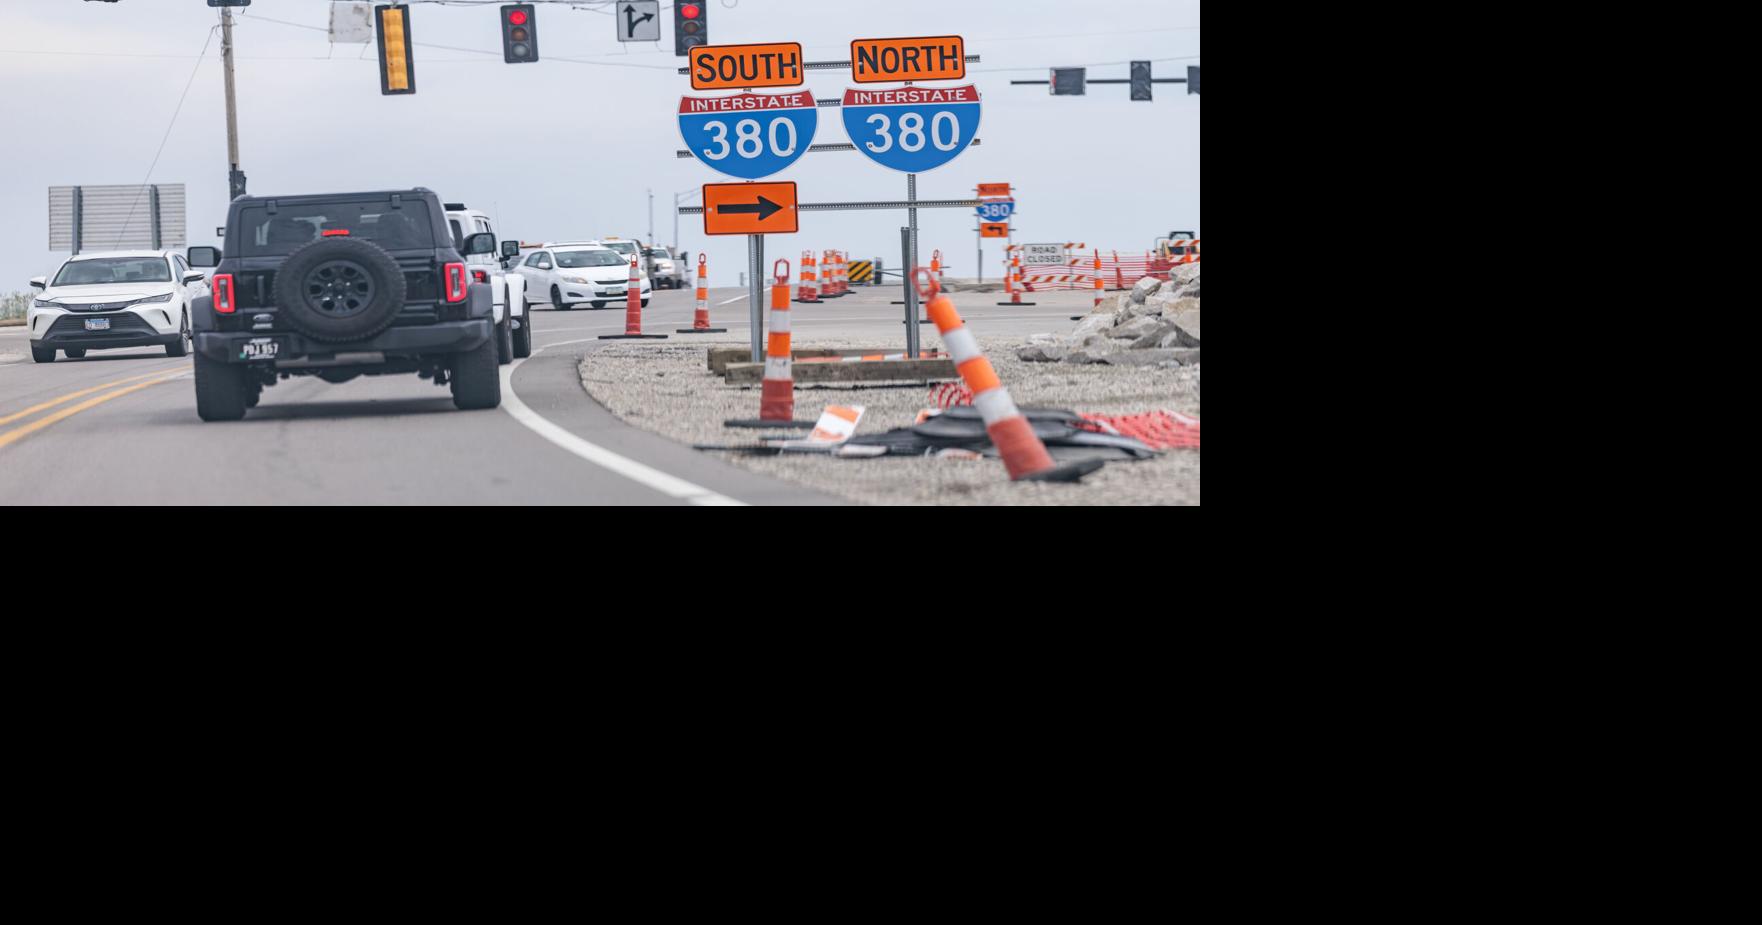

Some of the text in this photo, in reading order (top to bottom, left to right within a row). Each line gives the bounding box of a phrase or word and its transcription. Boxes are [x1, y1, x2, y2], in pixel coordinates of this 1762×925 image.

[697, 53, 797, 82] SOUTH
[858, 45, 958, 74] NORTH
[690, 94, 803, 111] INTERSTATE
[854, 89, 967, 104] INTERSTATE
[703, 117, 797, 160] 380
[866, 111, 959, 153] 380
[982, 204, 1009, 217] 380
[1031, 246, 1057, 254] ROAD
[1027, 255, 1062, 263] CLOSED
